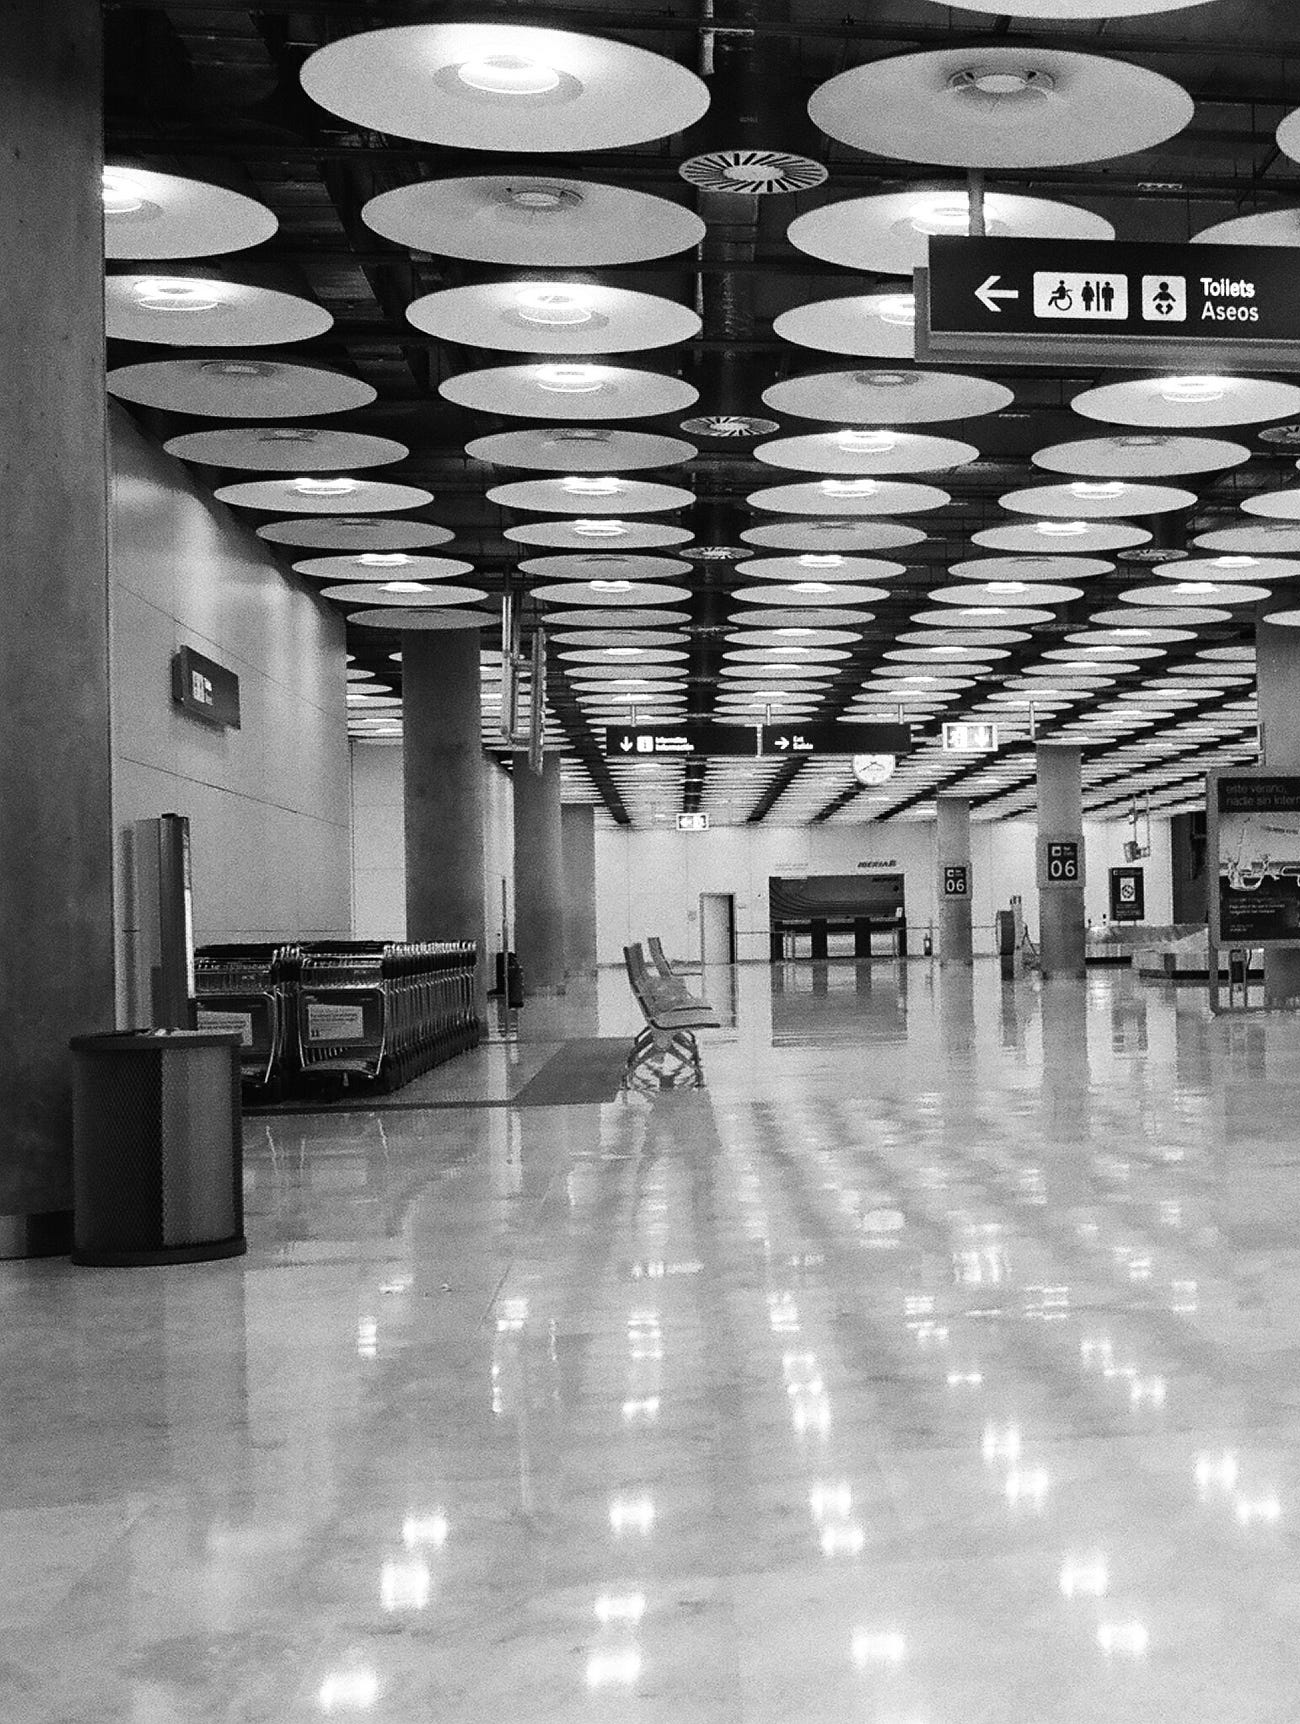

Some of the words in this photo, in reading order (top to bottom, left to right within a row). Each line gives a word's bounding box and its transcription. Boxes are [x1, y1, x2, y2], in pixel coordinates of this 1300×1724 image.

[1200, 277, 1255, 298] Toilets
[1201, 301, 1259, 321] Aseos
[857, 860, 890, 868] IBERIA
[1051, 860, 1076, 877] 06
[946, 879, 965, 892] 06
